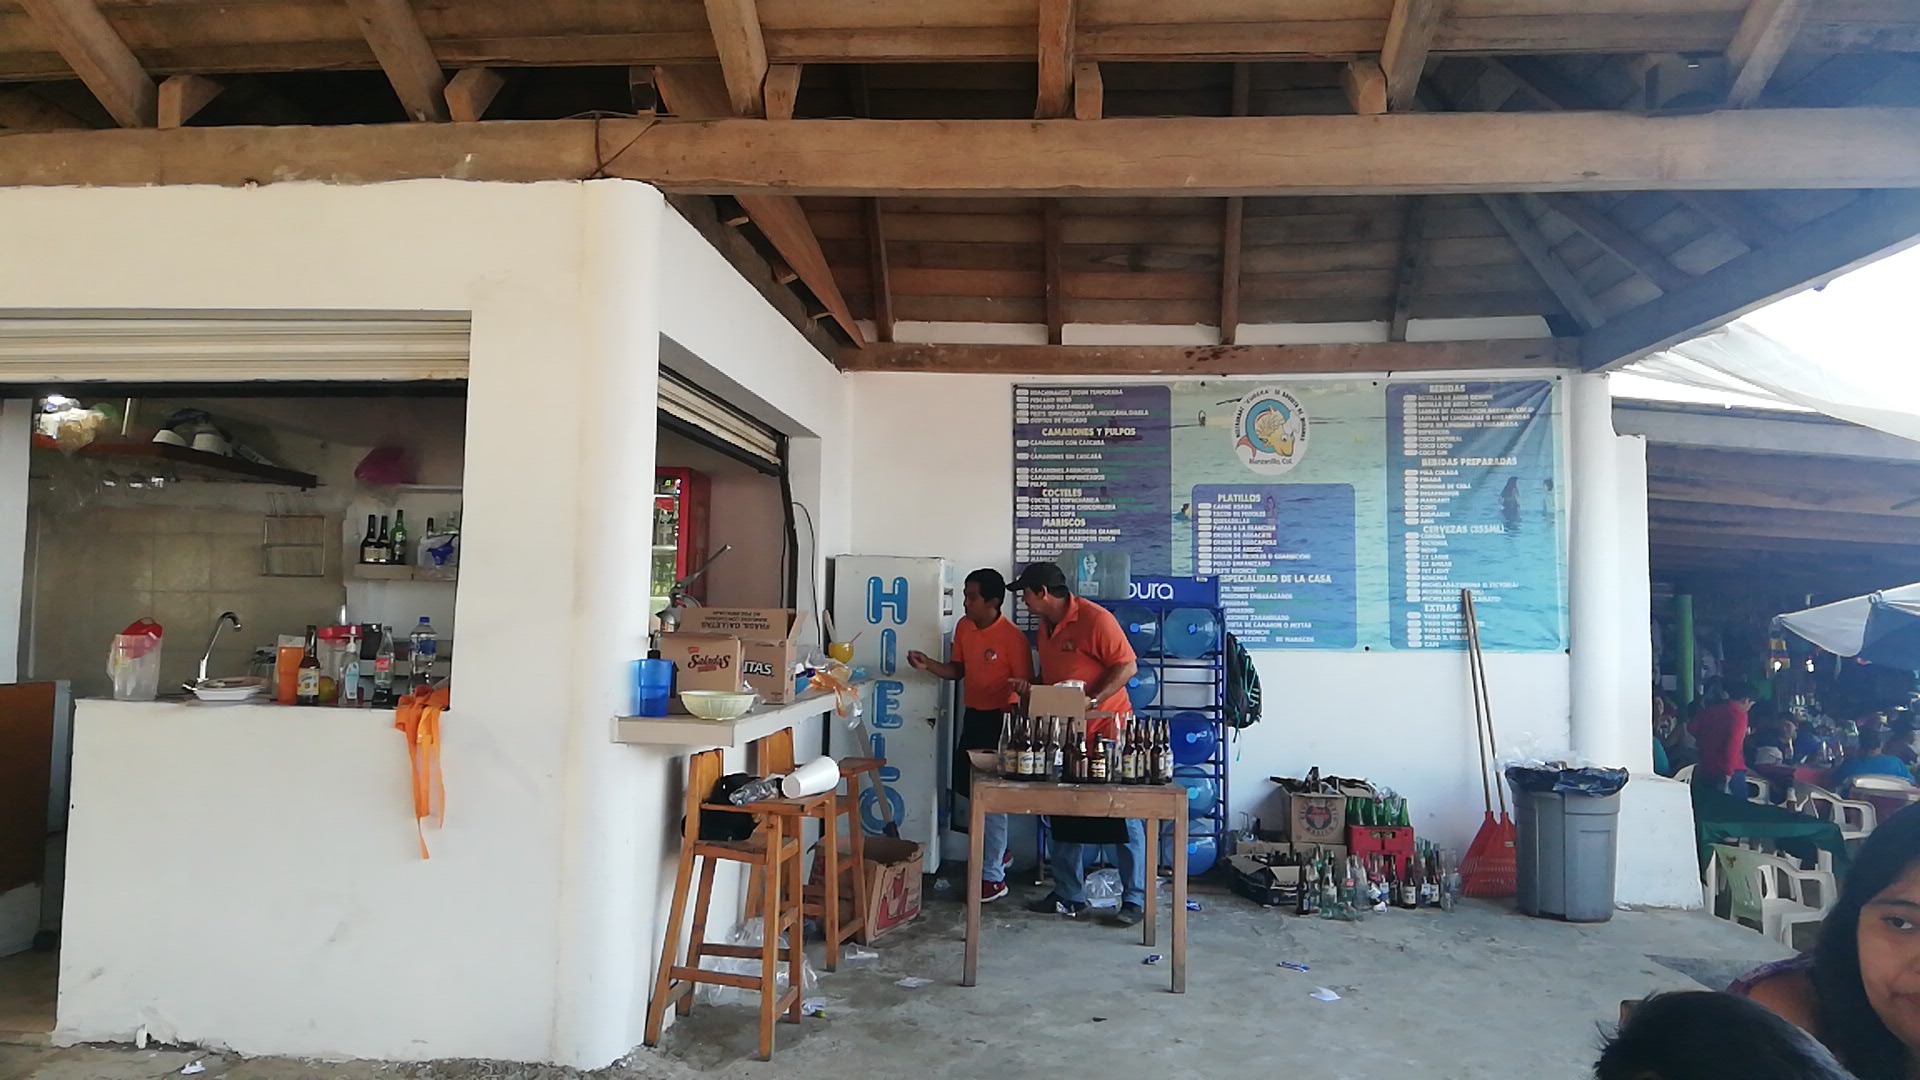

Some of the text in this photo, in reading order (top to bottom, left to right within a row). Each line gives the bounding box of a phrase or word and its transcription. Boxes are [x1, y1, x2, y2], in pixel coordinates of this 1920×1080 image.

[1430, 384, 1466, 393] BEBIDAS
[1042, 428, 1136, 436] CAMARONES Y PULPOS
[1422, 458, 1518, 466] BEBIDAS PREPARADAS
[1042, 488, 1082, 497] COCTELES
[1218, 494, 1260, 502] PLATILLOS
[1042, 518, 1086, 526] MARISCOS
[1423, 525, 1468, 534] CERVEZAS
[1220, 574, 1332, 583] ESPECIALIDAD DE LA CASA
[1424, 604, 1458, 612] EXTRAS
[858, 576, 909, 835] HIELO
